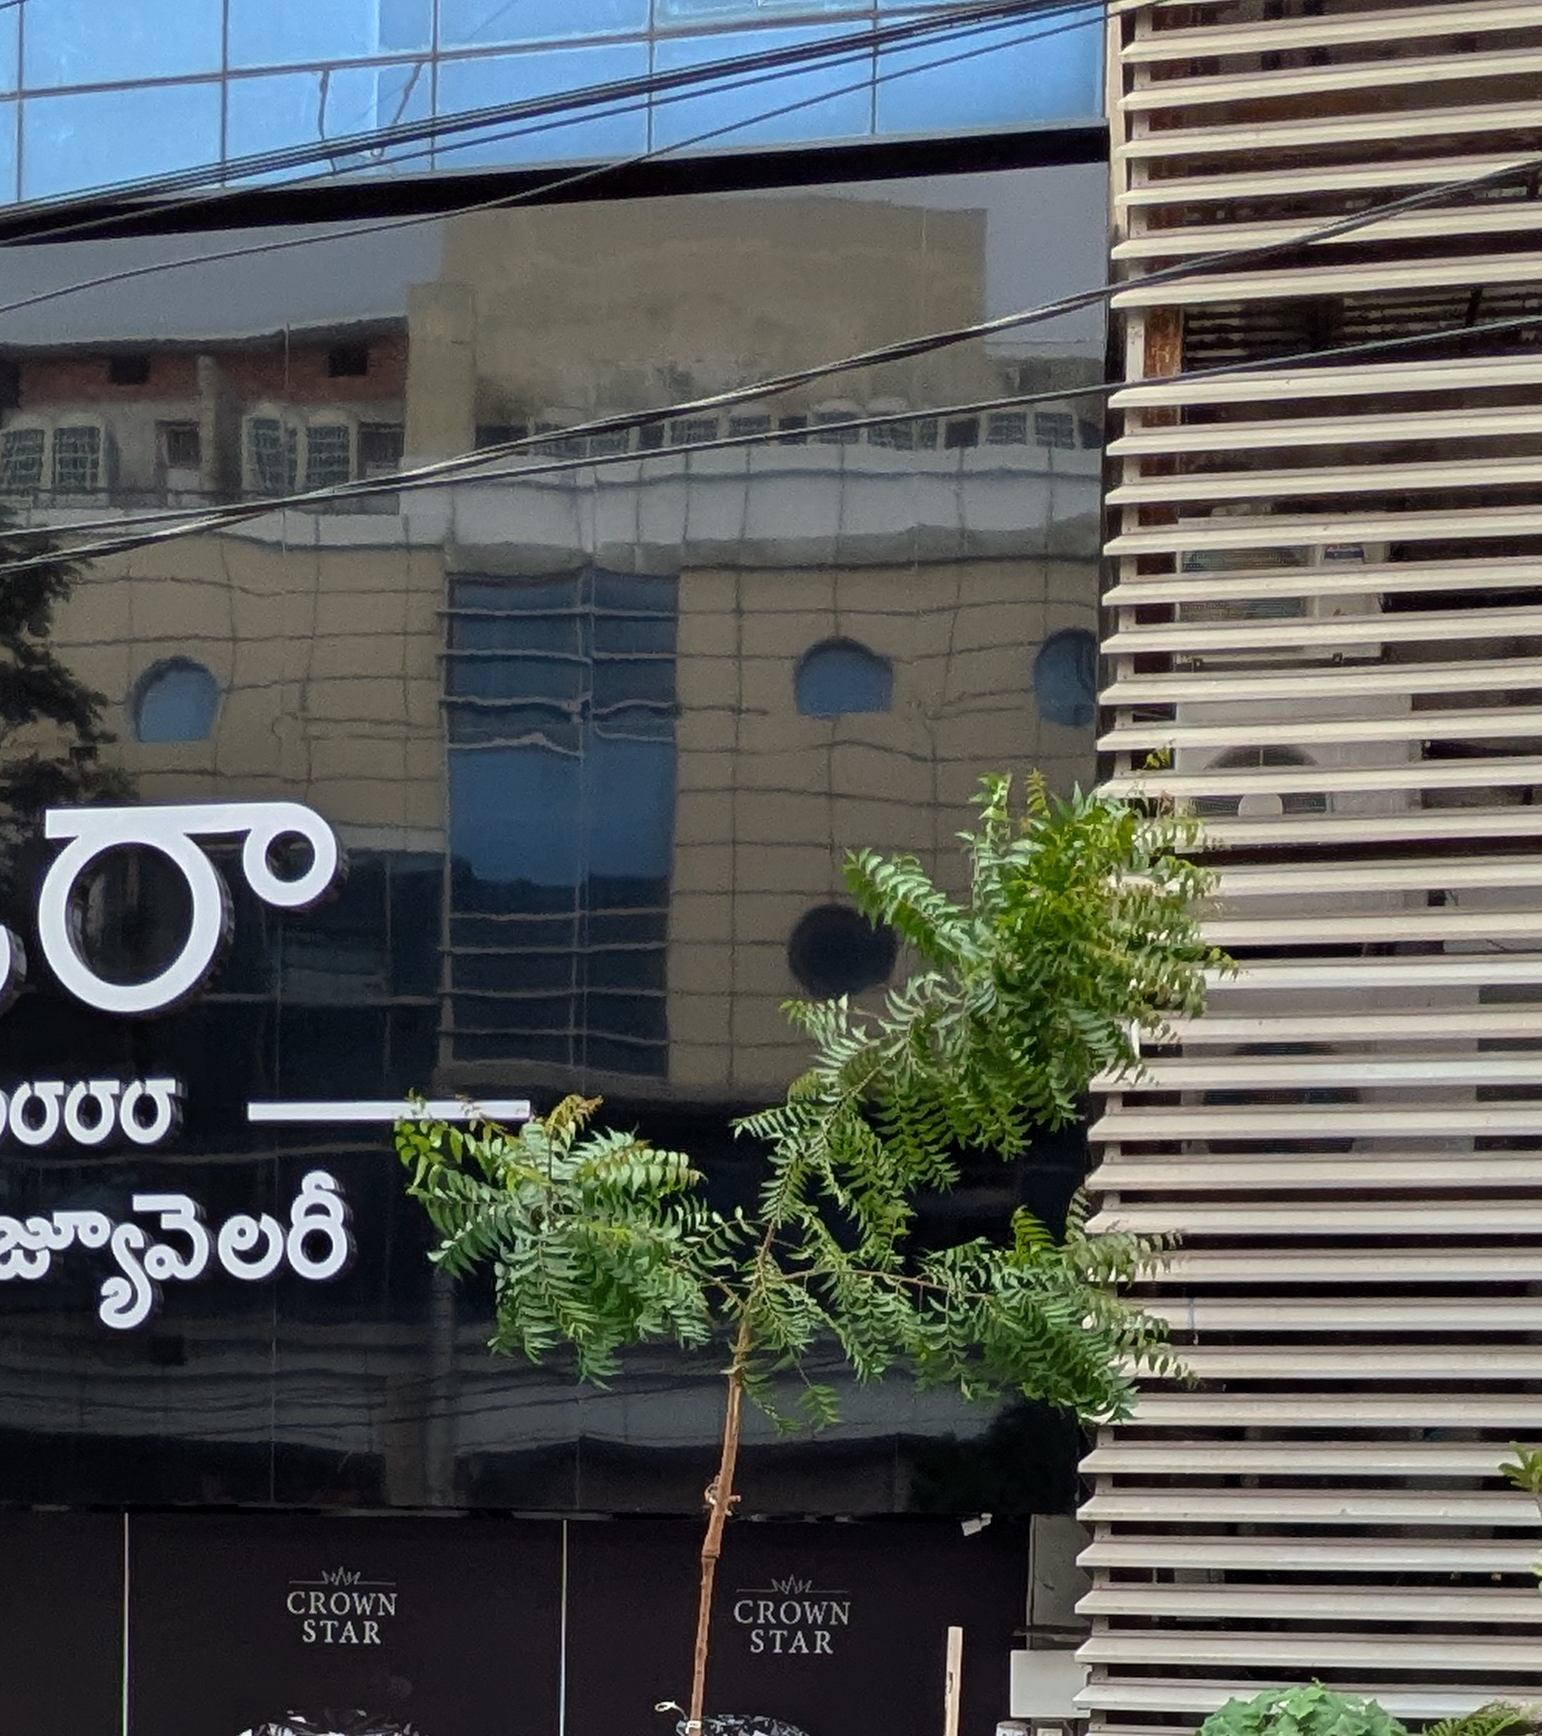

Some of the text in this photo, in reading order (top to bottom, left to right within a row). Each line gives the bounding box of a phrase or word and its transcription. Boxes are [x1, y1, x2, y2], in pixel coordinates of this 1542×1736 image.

[286, 1590, 398, 1617] CROWN
[733, 1600, 851, 1626] CROWN
[302, 1619, 381, 1645] STAR
[750, 1629, 834, 1655] STAR
